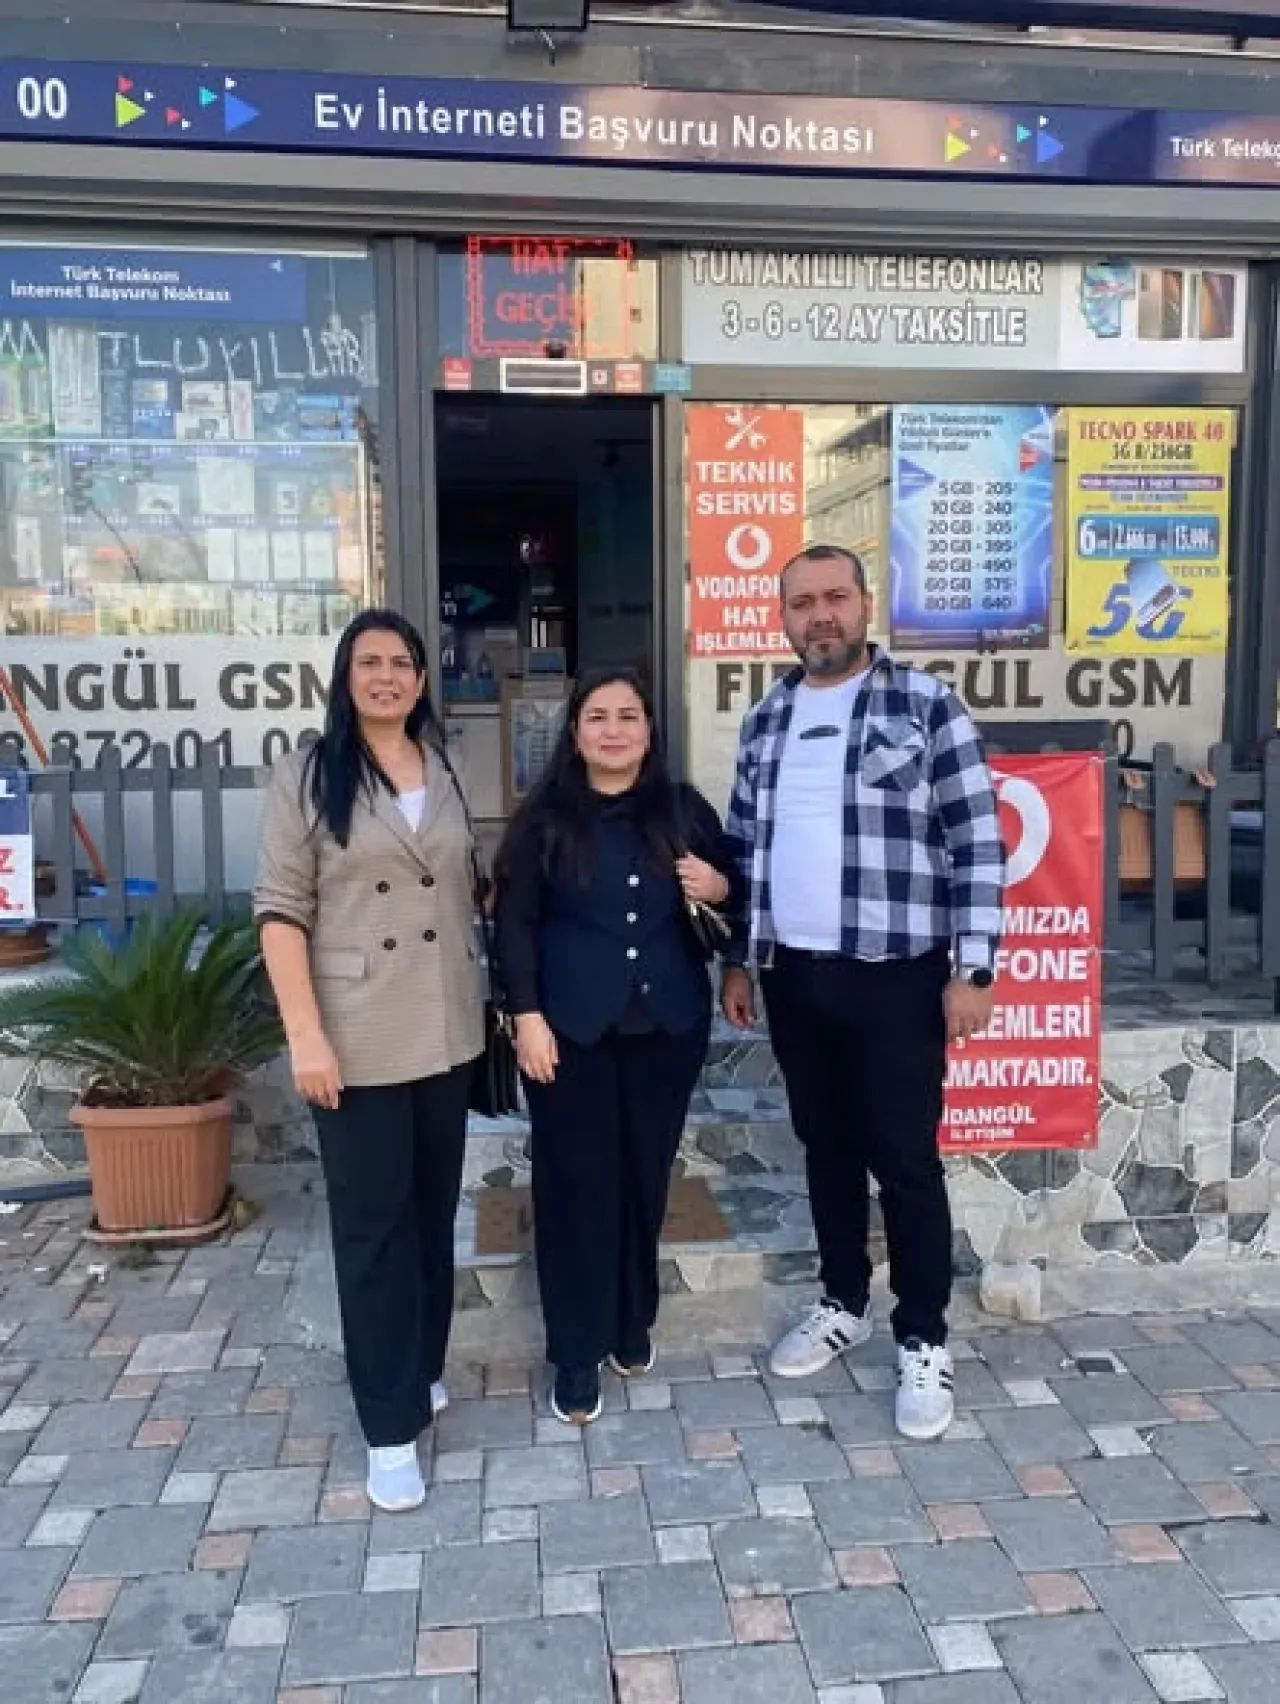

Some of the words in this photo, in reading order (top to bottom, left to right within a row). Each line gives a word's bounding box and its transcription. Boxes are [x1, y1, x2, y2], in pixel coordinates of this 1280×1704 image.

[17, 77, 68, 120] 00
[314, 93, 363, 131] Ev
[378, 87, 545, 140] İnterneti
[560, 105, 718, 150] Başvuru
[733, 115, 875, 153] Noktası
[1171, 136, 1215, 157] Türk
[61, 265, 101, 282] Türk
[107, 267, 180, 284] Telekom
[760, 252, 855, 289] AKILLI
[863, 255, 1043, 295] TELEFONLAR
[11, 280, 82, 299] İnternet
[87, 284, 159, 303] Başvuru
[165, 286, 232, 303] Noktası
[721, 300, 740, 340] 3
[763, 300, 783, 341] 6
[806, 303, 842, 342] 12
[846, 303, 886, 343] AY
[890, 299, 1027, 346] TAKSİTLE
[1080, 421, 1137, 441] TECNO
[1142, 421, 1198, 441] SPARK
[695, 456, 796, 484] TEKNİK
[695, 486, 796, 515] SERVİS
[722, 606, 771, 627] HAT
[0, 647, 197, 713] NGÜL
[1065, 657, 1193, 710] GSM
